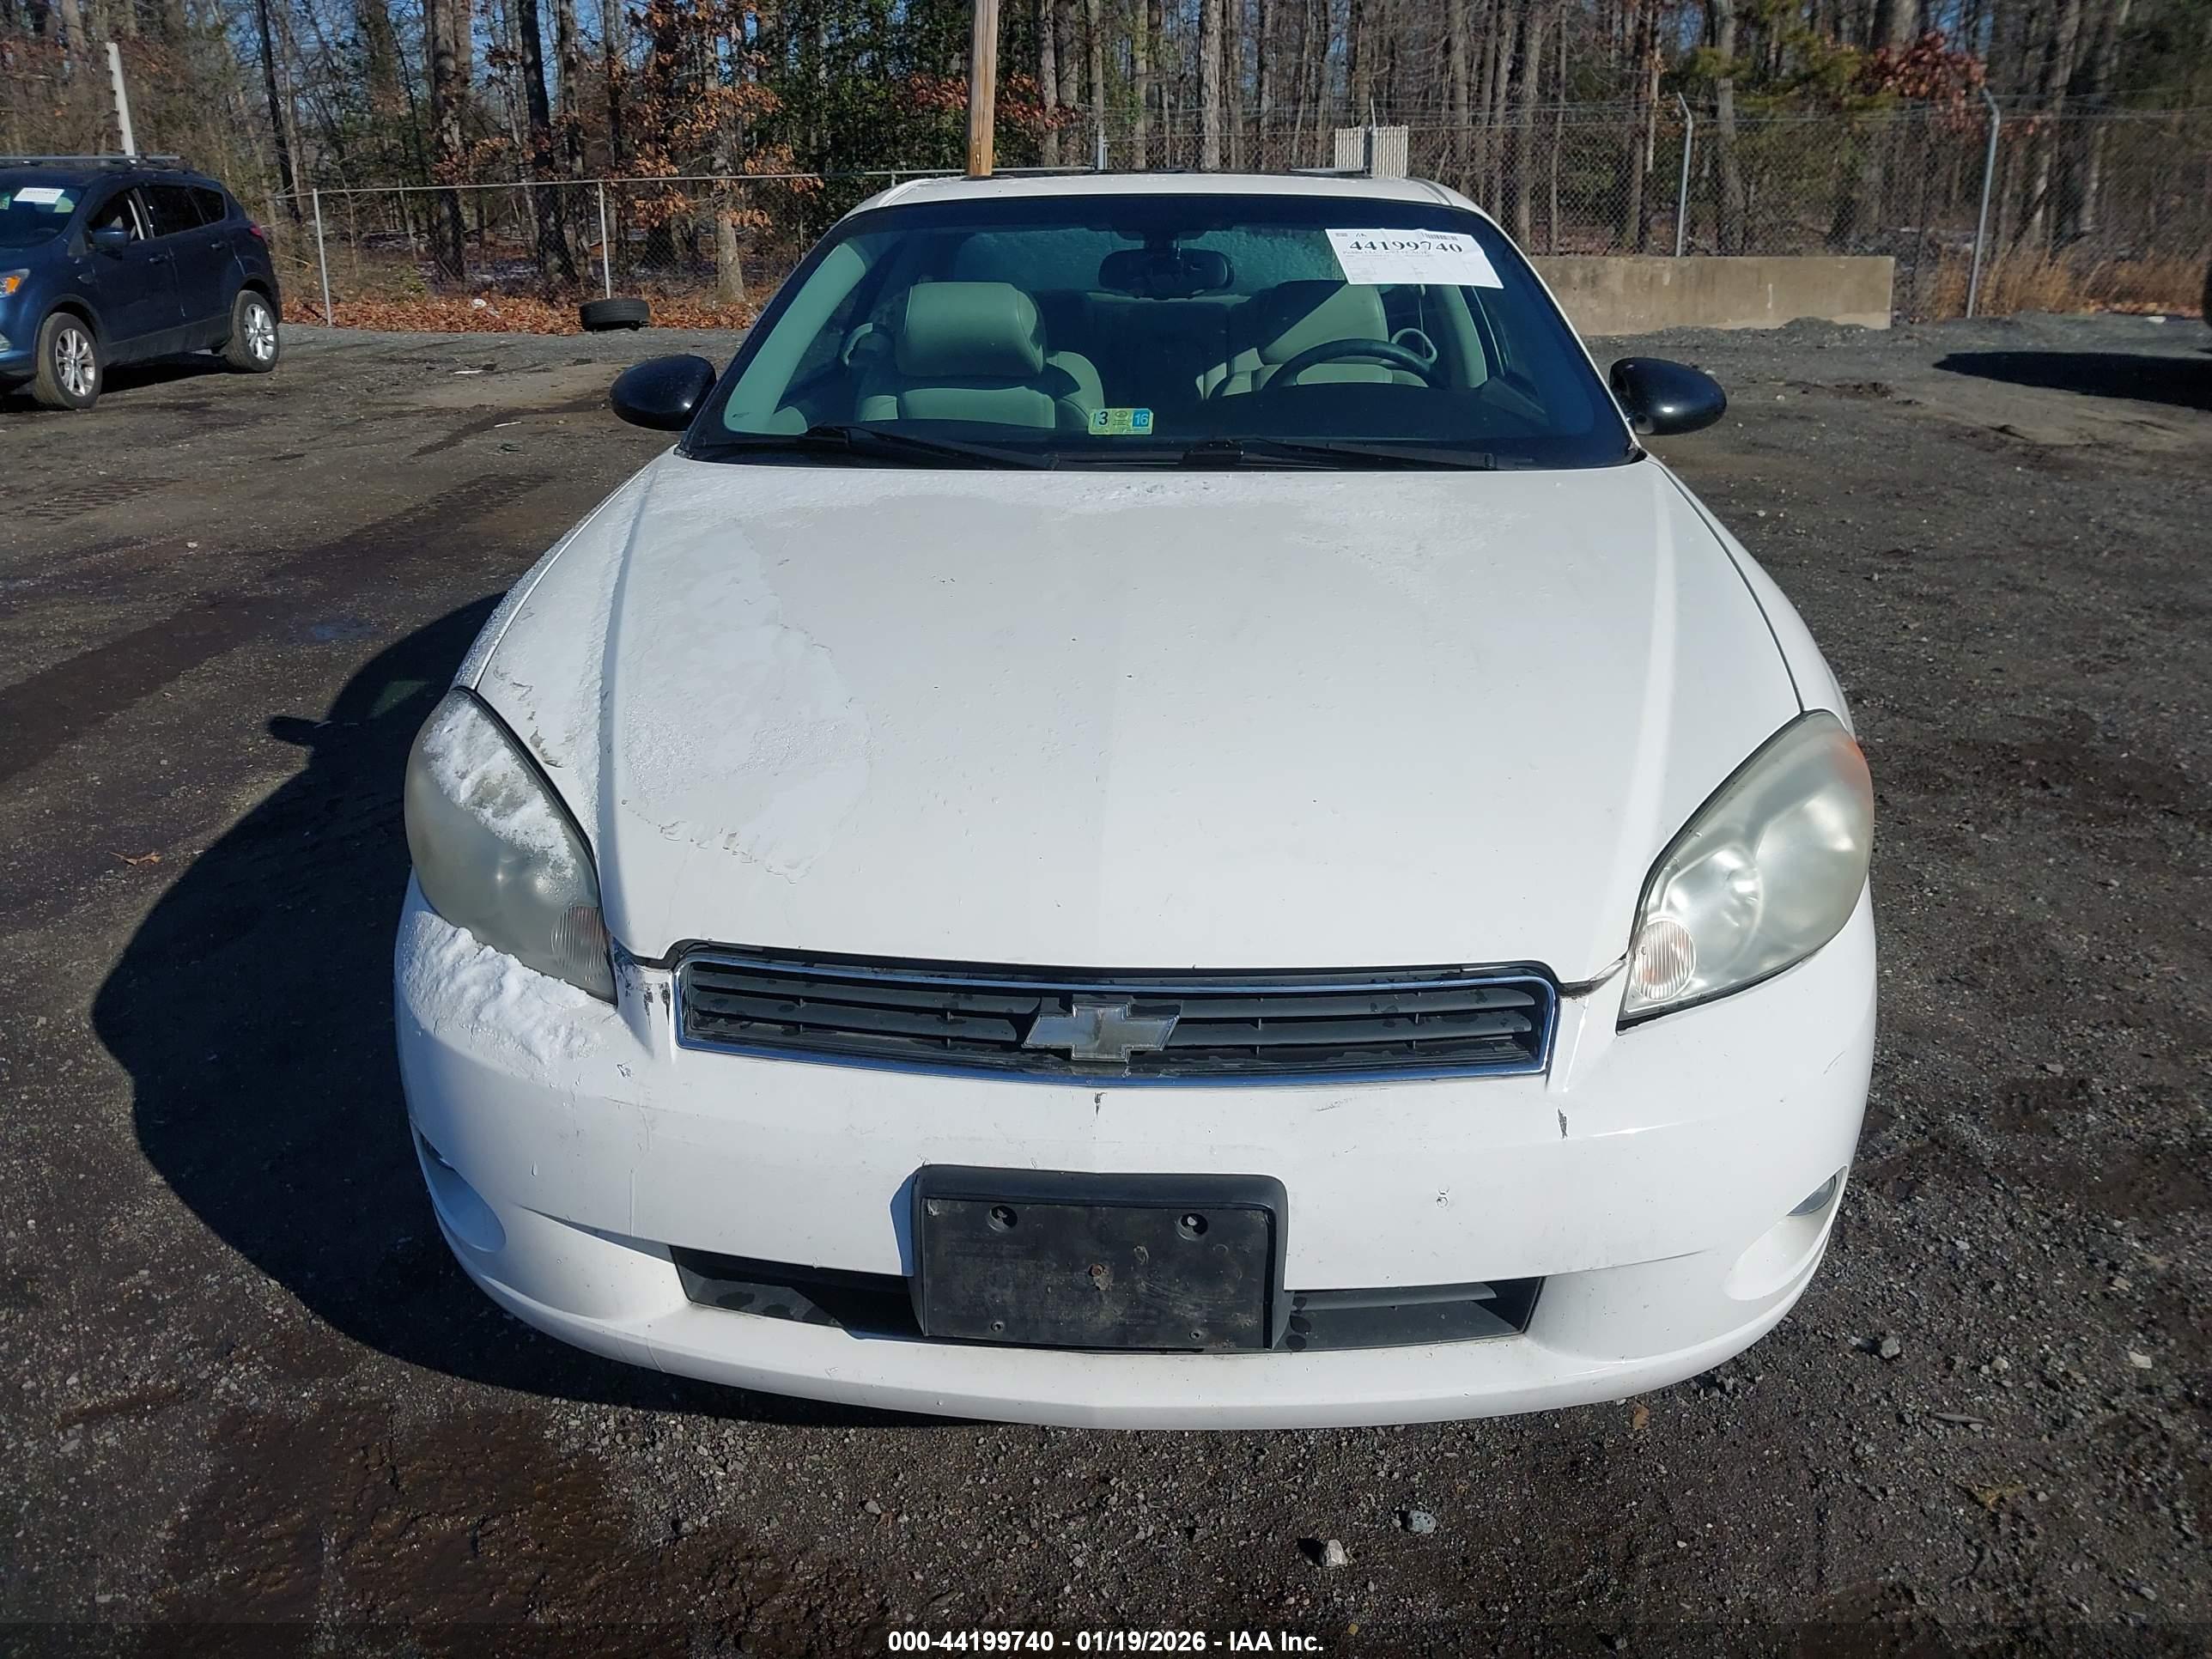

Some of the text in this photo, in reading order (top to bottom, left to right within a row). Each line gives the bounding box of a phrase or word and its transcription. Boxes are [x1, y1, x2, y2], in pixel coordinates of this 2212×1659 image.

[1349, 240, 1463, 253] 44199740
[1098, 411, 1109, 425] 3
[1134, 414, 1149, 425] 16
